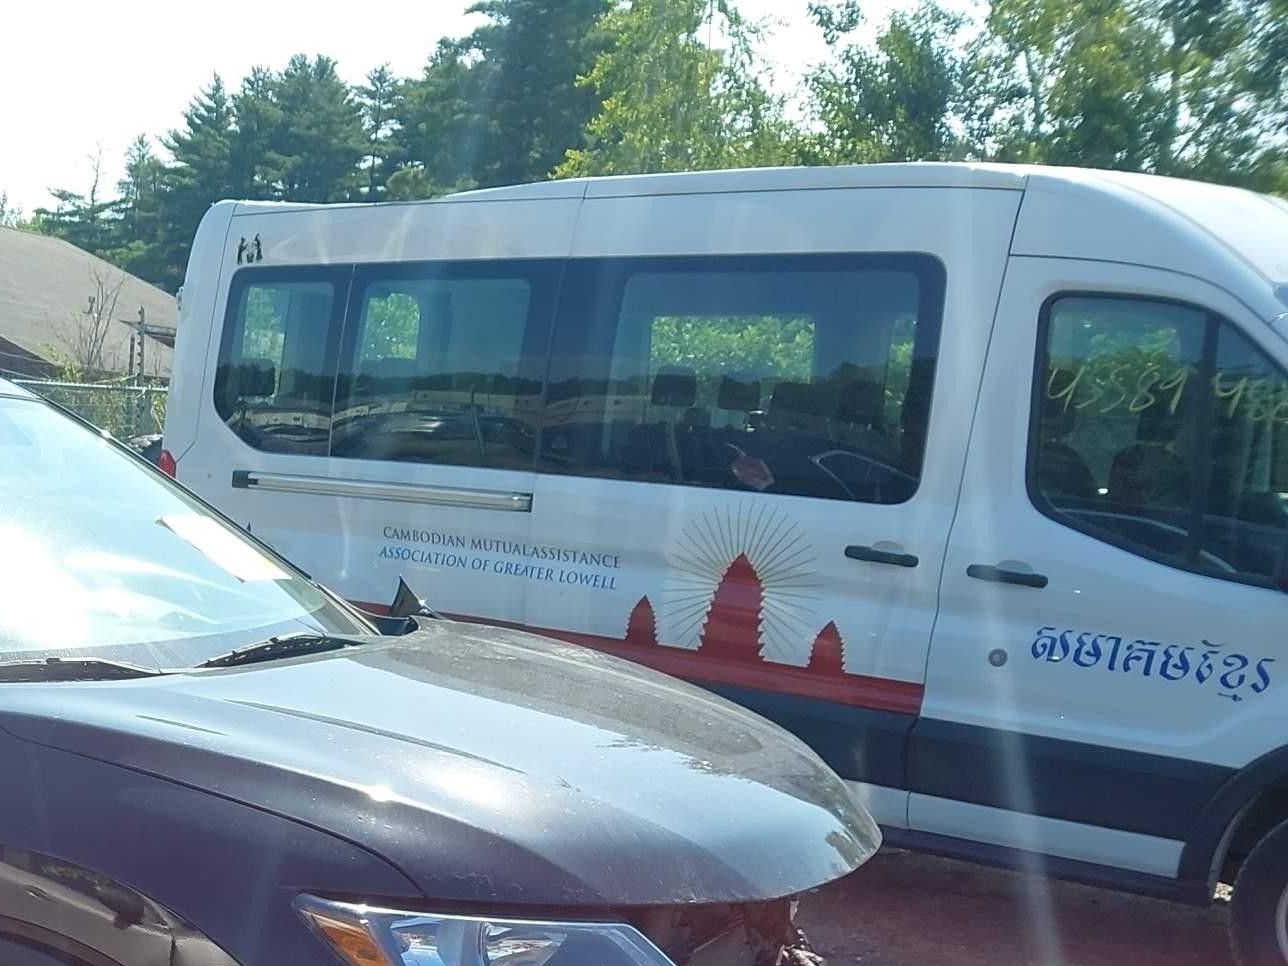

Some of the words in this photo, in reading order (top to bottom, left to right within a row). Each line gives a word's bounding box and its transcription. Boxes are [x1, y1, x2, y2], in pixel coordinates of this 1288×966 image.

[382, 526, 466, 548] CAMBODIAN
[379, 545, 468, 569] ASSOCIATION
[471, 557, 491, 572] OF
[493, 560, 554, 582] GREATER
[558, 569, 617, 590] LOWELL
